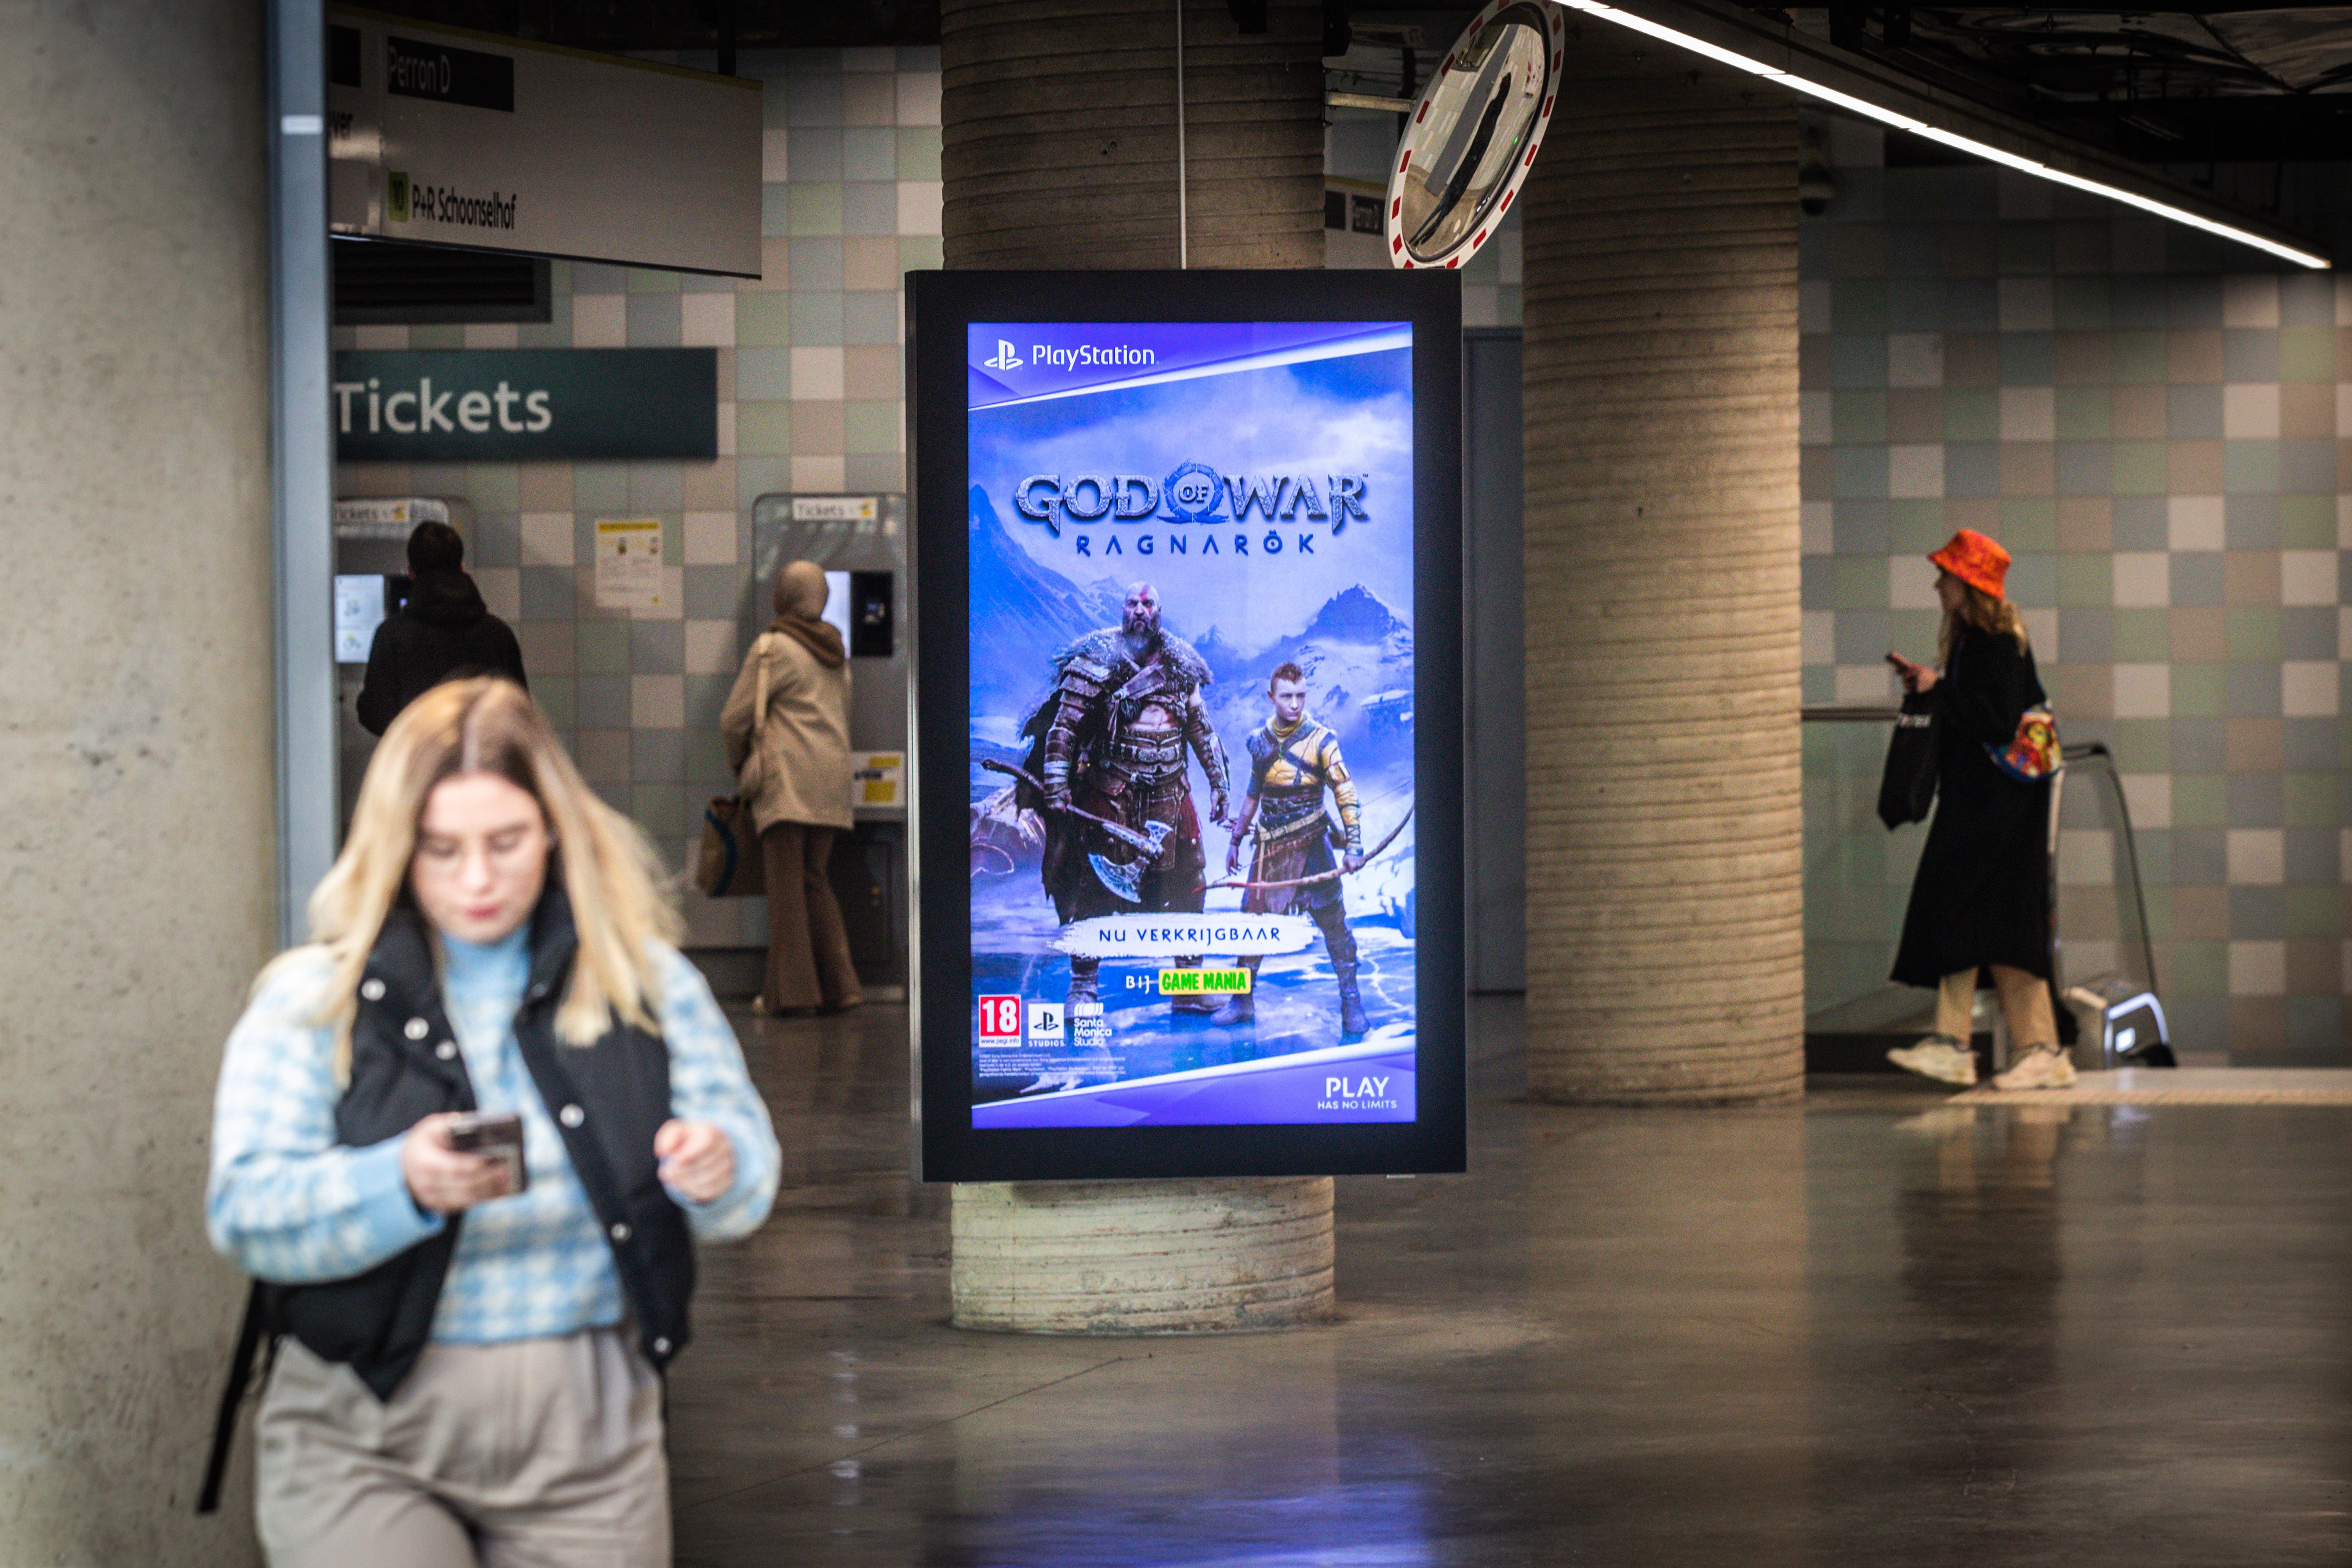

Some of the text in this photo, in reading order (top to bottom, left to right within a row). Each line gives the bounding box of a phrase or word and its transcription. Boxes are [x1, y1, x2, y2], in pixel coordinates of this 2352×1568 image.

[387, 45, 451, 94] Perron D
[413, 184, 435, 221] P+R
[438, 186, 517, 230] Schoonselhof
[1033, 345, 1155, 371] PlayStation
[333, 377, 552, 434] Tickets
[1015, 474, 1160, 536] GOD
[1179, 483, 1209, 503] OF
[1223, 473, 1368, 533] WAR
[1076, 530, 1314, 557] RAGNARÖK
[1099, 927, 1281, 946] NU VERKRIJGBAAR
[1125, 971, 1247, 995] BIJ GAME MANIA
[982, 999, 1017, 1033] 18
[1074, 1018, 1103, 1027] Santa
[1074, 1028, 1112, 1037] Monica
[1074, 1037, 1104, 1047] Studio
[1326, 1076, 1390, 1098] PLAY
[1318, 1100, 1397, 1109] HAS NO LIMITS
